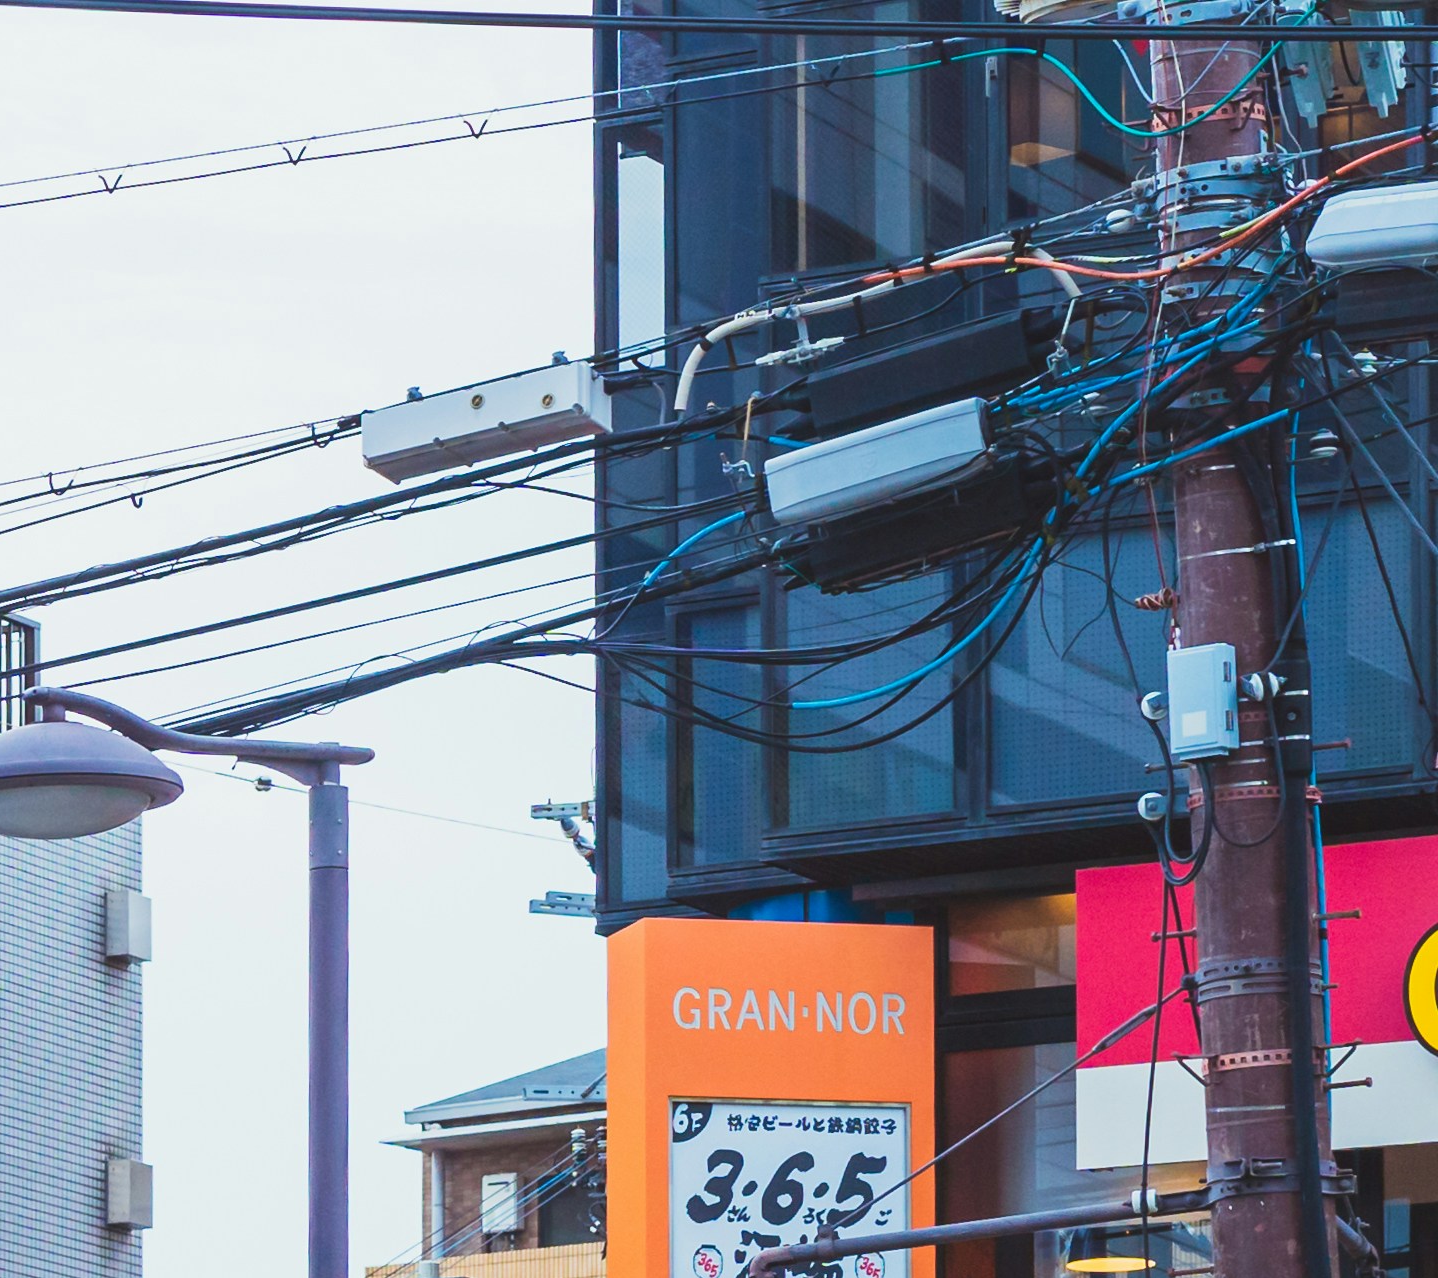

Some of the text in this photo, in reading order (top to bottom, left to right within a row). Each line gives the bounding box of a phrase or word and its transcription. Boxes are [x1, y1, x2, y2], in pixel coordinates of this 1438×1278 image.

[672, 1103, 703, 1134] 6F
[727, 1205, 751, 1224] さん
[697, 1252, 719, 1278] 365
